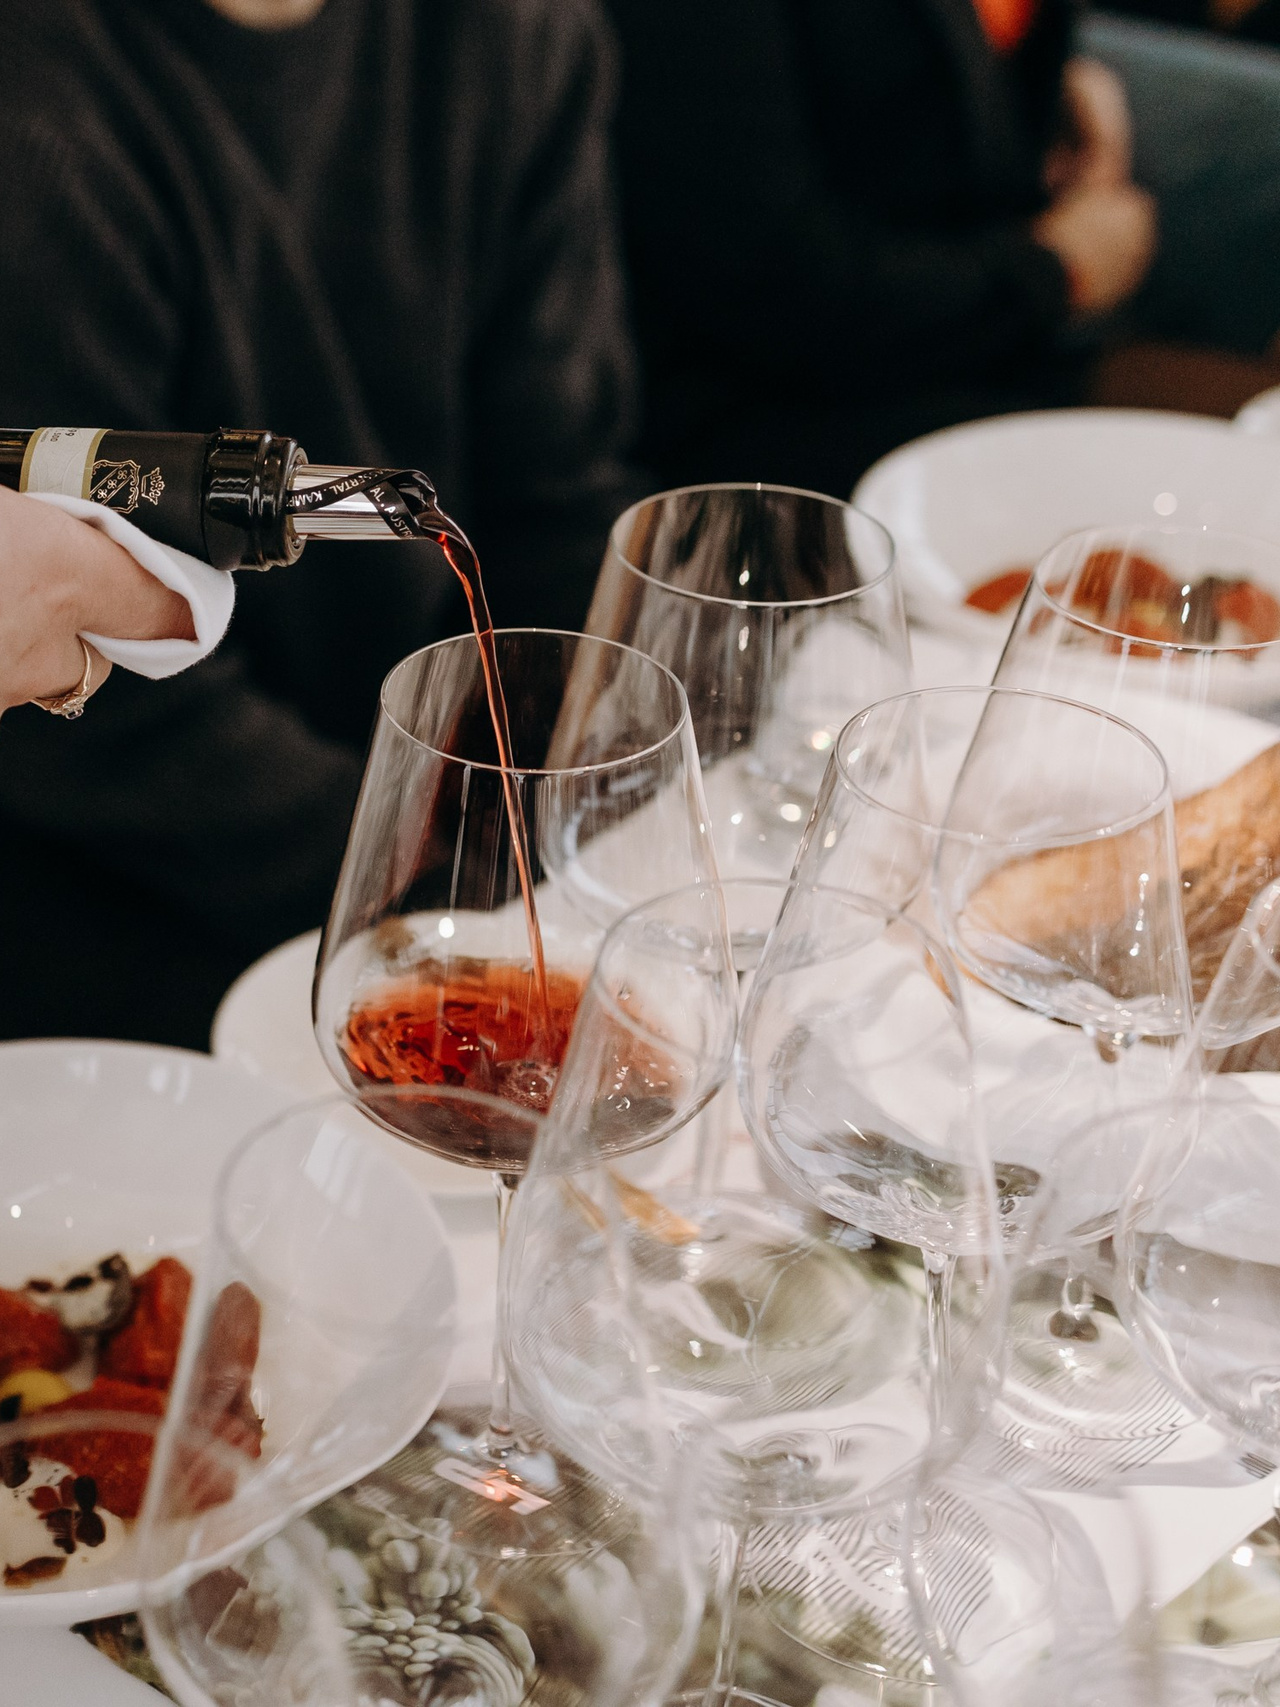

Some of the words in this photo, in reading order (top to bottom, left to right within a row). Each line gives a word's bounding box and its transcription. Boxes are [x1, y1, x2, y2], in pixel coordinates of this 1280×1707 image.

[286, 490, 322, 507] KAMP
[370, 485, 385, 502] AL
[384, 506, 417, 539] AUSTR
